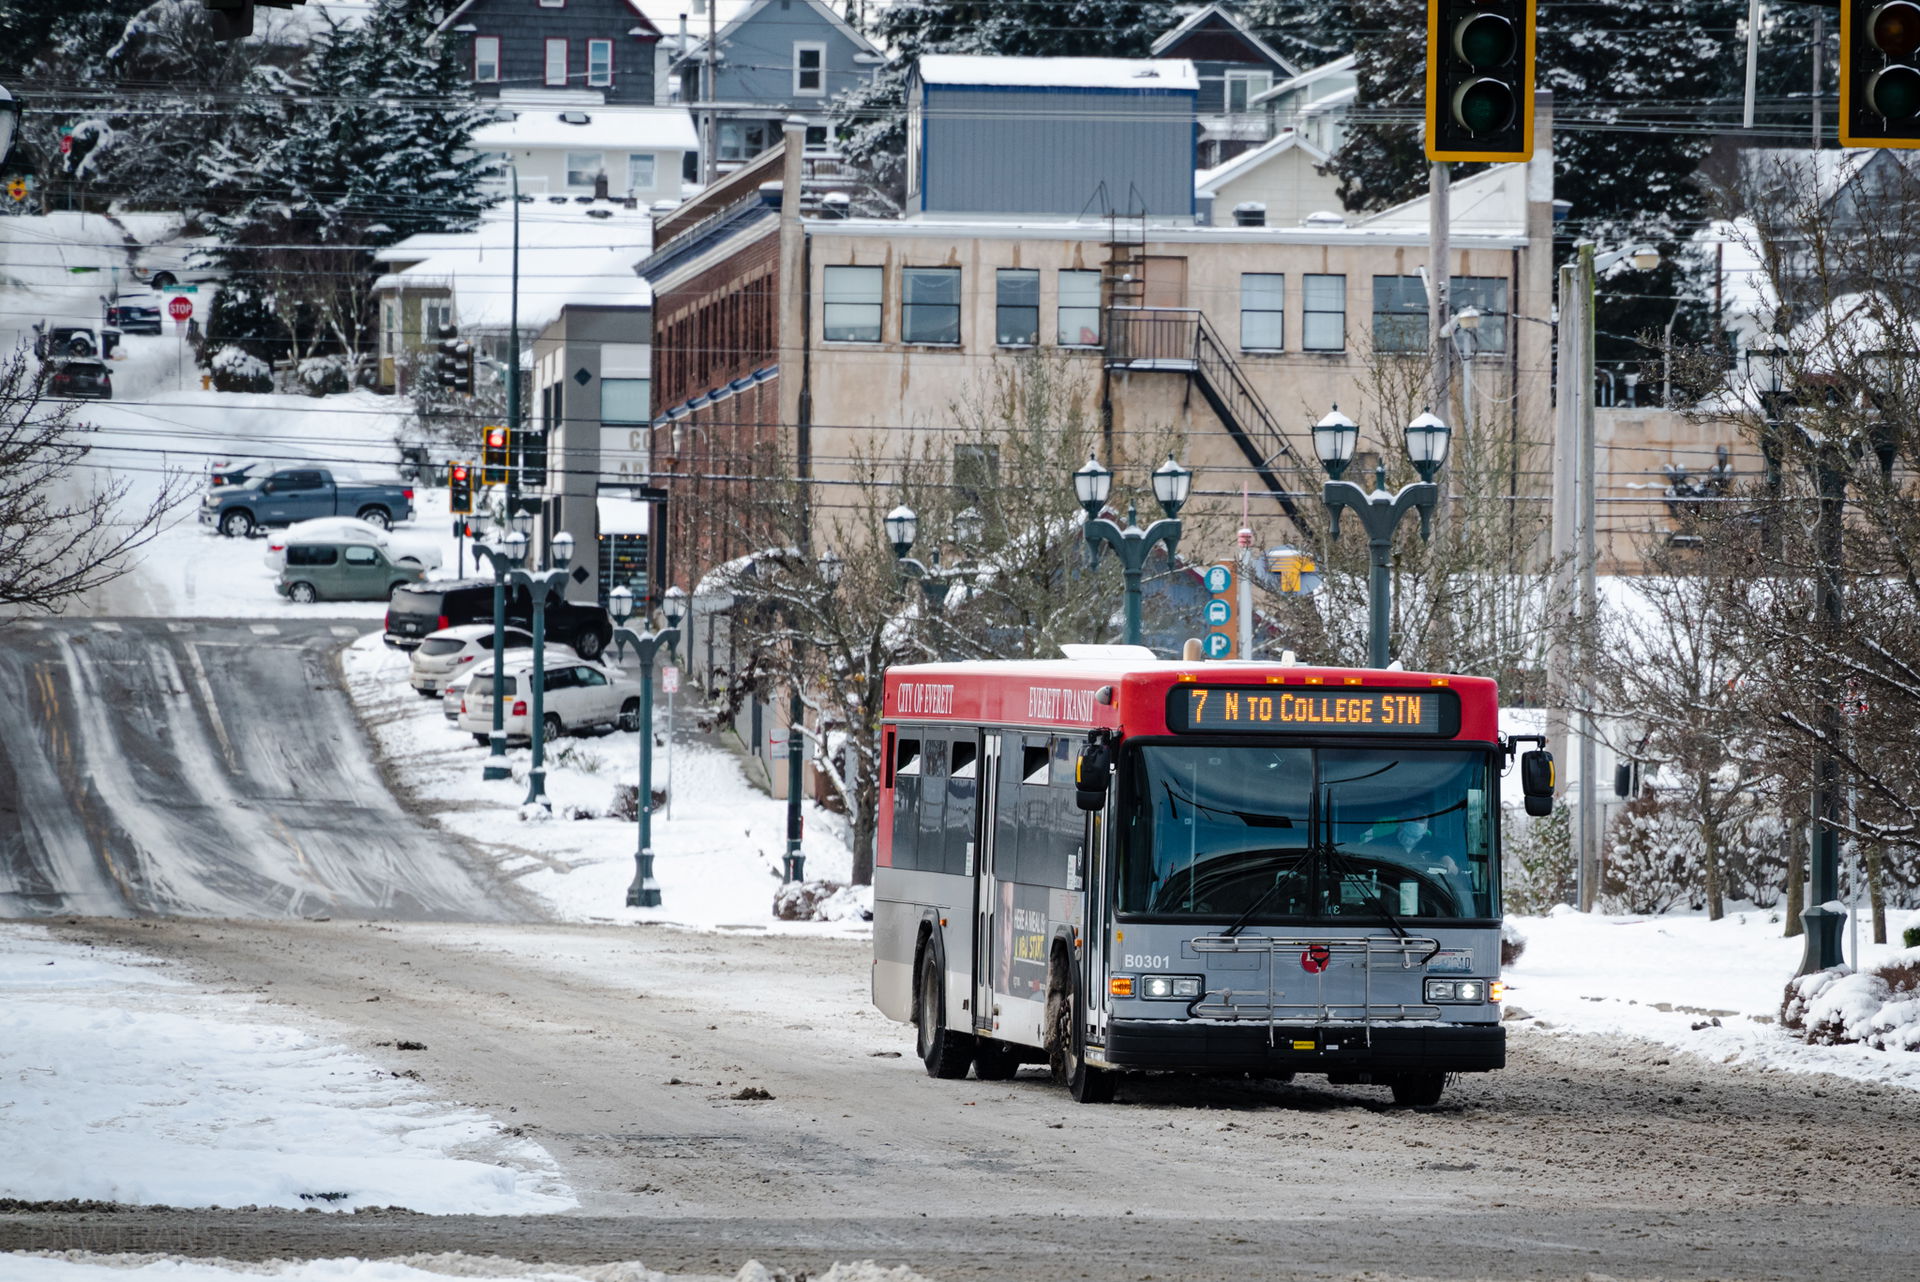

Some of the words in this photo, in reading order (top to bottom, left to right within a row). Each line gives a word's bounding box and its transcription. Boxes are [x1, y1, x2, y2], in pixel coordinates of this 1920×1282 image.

[170, 303, 192, 315] STOP
[1211, 635, 1227, 656] P
[897, 683, 914, 713] CITY
[914, 683, 924, 713] OF
[924, 684, 955, 714] EVERETT
[1028, 687, 1061, 720] EVERETT
[1062, 689, 1095, 722] TRANSIT
[1191, 689, 1208, 723] 7
[1225, 692, 1239, 721] N
[1381, 695, 1421, 724] STN
[1124, 954, 1170, 969] B0301
